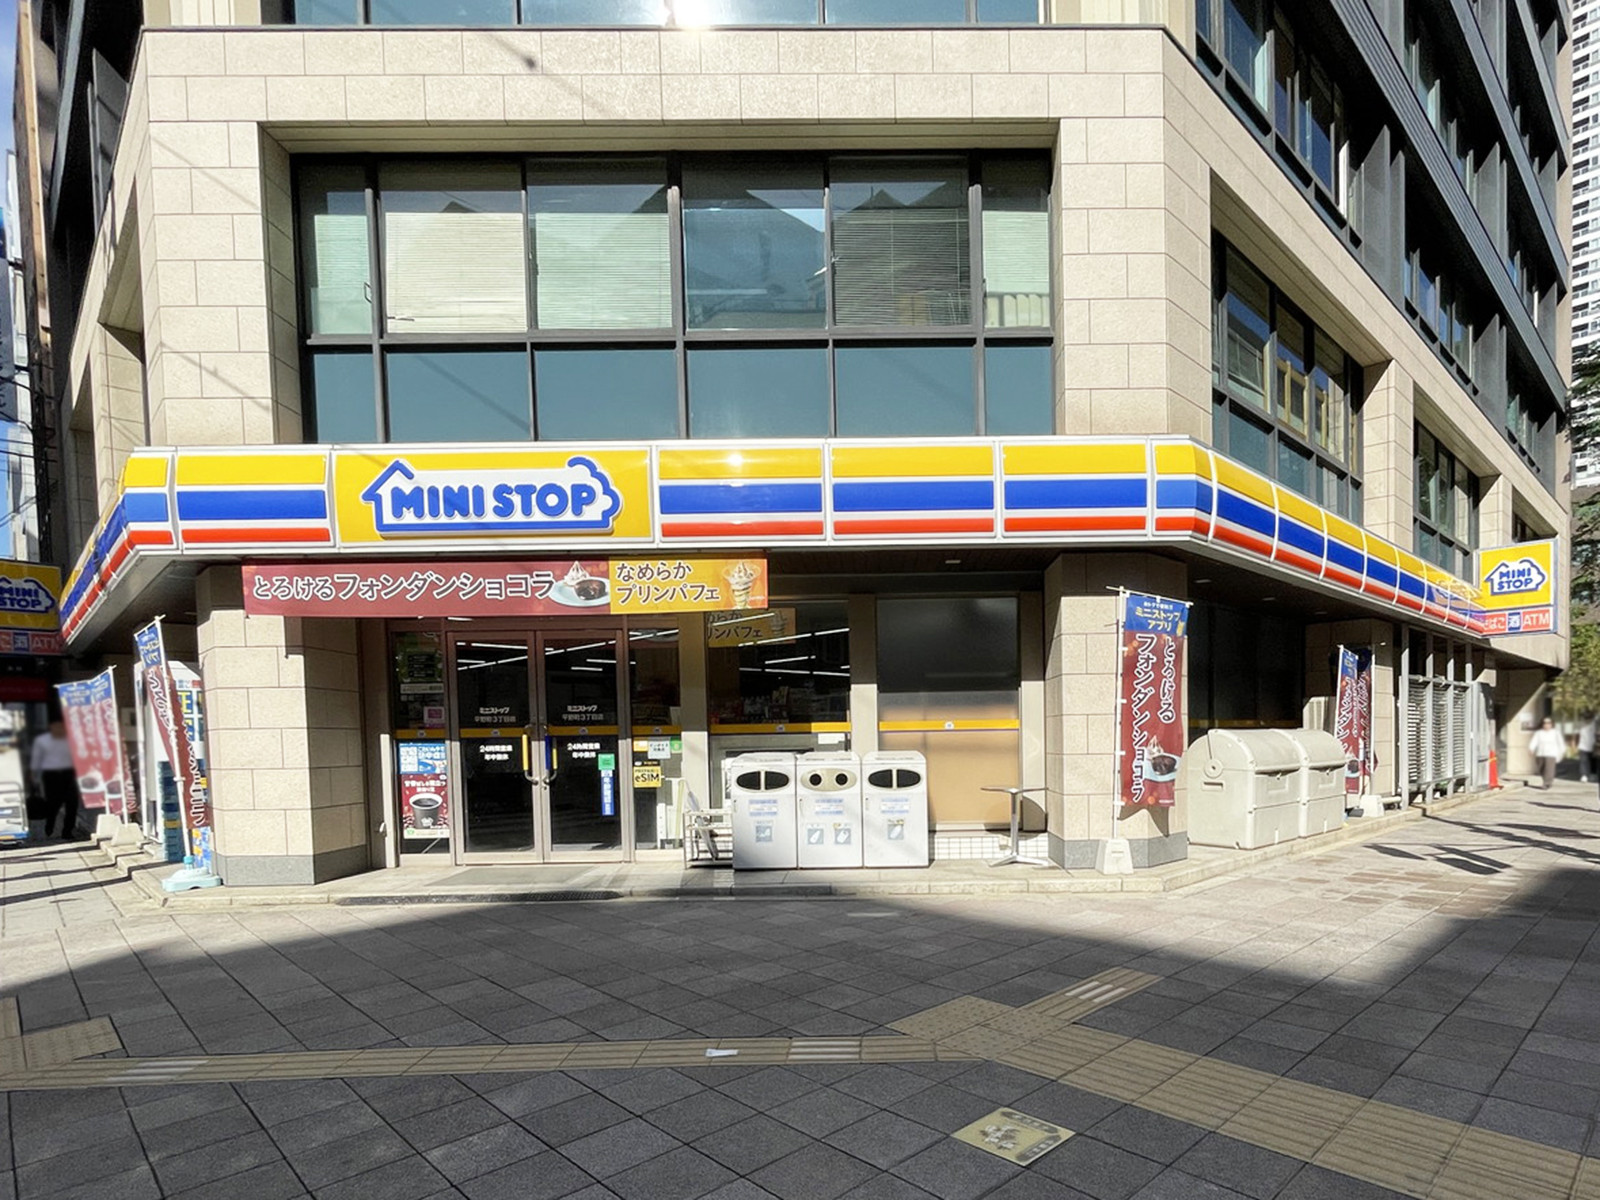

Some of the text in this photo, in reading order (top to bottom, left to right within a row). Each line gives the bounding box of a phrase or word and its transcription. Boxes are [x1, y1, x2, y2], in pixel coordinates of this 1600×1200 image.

[616, 562, 692, 582] なめらか
[1499, 567, 1531, 580] MINI
[254, 569, 556, 601] とろけるフォンダンショコラ
[1497, 577, 1533, 591] STOP
[616, 584, 720, 604] プリンパフェ
[1523, 612, 1550, 627] ATM
[635, 773, 660, 783] eSIM
